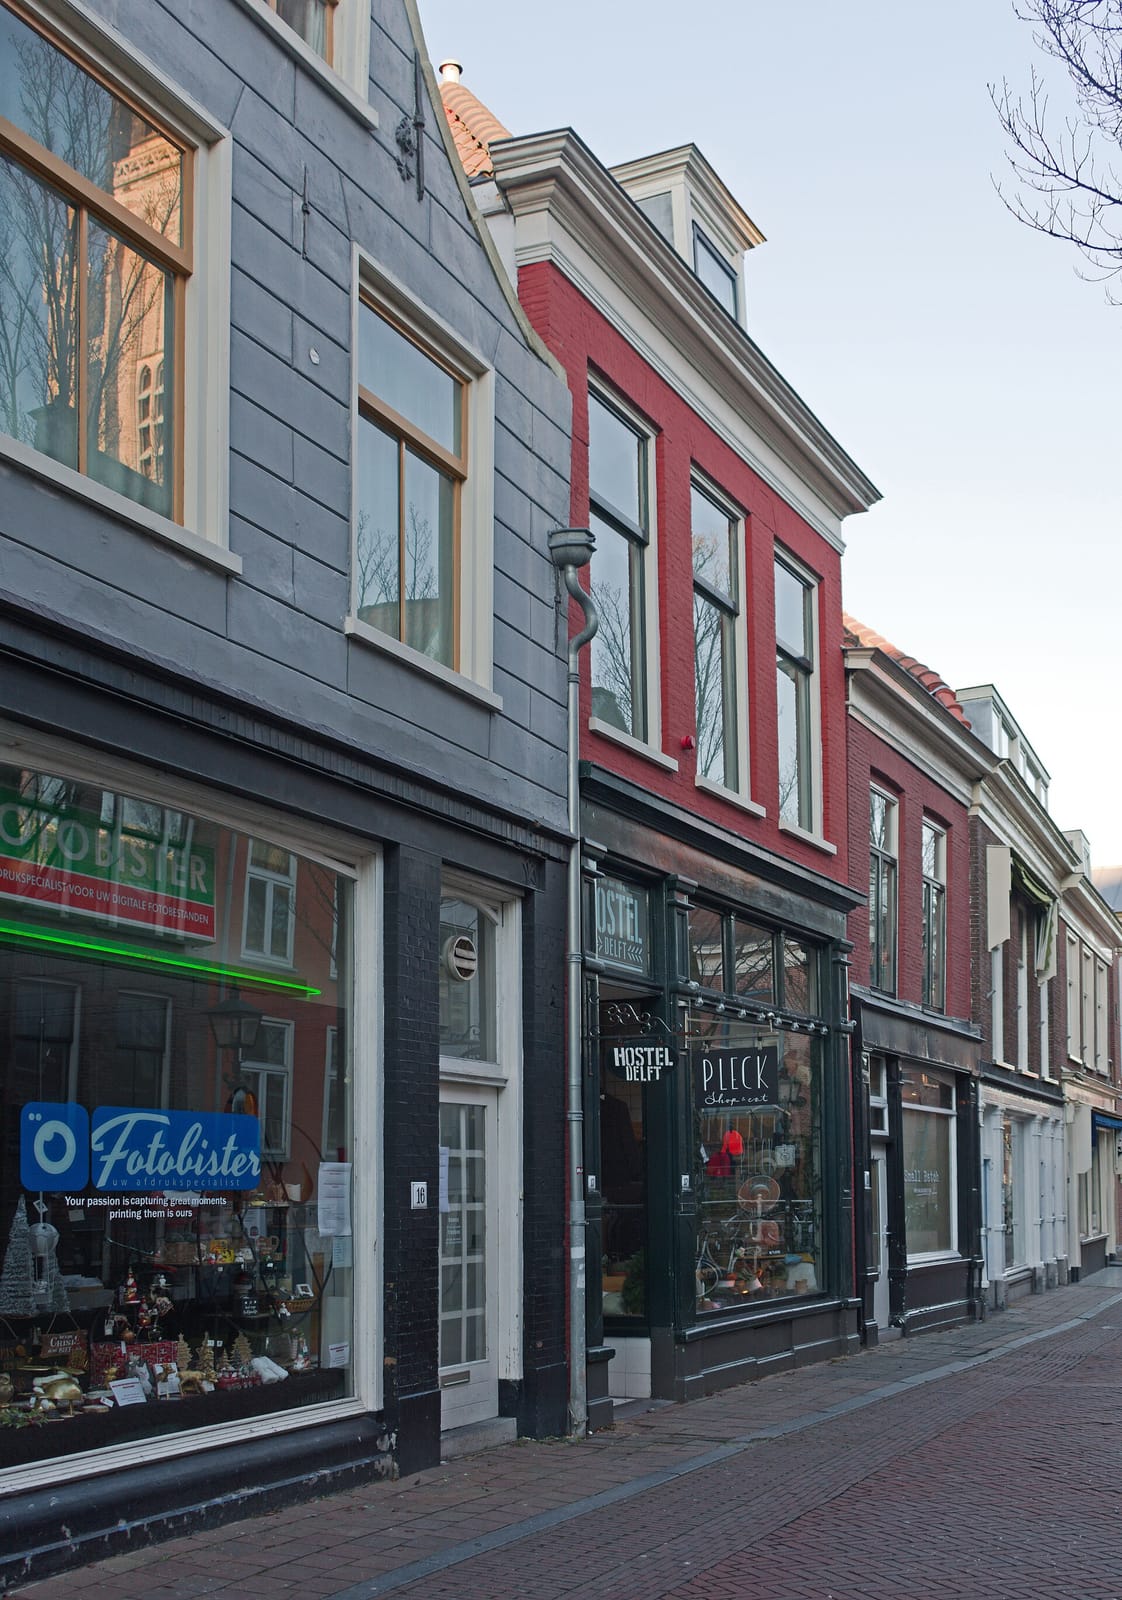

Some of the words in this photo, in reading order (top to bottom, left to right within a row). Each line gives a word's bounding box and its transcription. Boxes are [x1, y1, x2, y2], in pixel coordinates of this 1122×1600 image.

[69, 883, 94, 898] VOOR
[96, 890, 110, 903] UW
[112, 894, 146, 910] DIGITALE
[147, 902, 209, 925] FOTOBESTANDEN
[604, 936, 627, 960] DELFT
[613, 1047, 674, 1067] HOSTEL
[625, 1065, 662, 1081] DELFT
[702, 1055, 769, 1091] PLECK
[91, 1112, 261, 1189] Fotobister
[136, 1177, 240, 1188] afdrukspecialist
[64, 1196, 85, 1206] Your
[87, 1196, 120, 1208] passion
[122, 1196, 130, 1205] is
[130, 1196, 169, 1207] capturing
[170, 1196, 190, 1207] great
[191, 1197, 227, 1206] moments
[416, 1187, 426, 1204] 16
[109, 1209, 142, 1220] printing
[144, 1208, 165, 1218] them
[167, 1208, 174, 1218] is
[175, 1209, 193, 1218] ours
